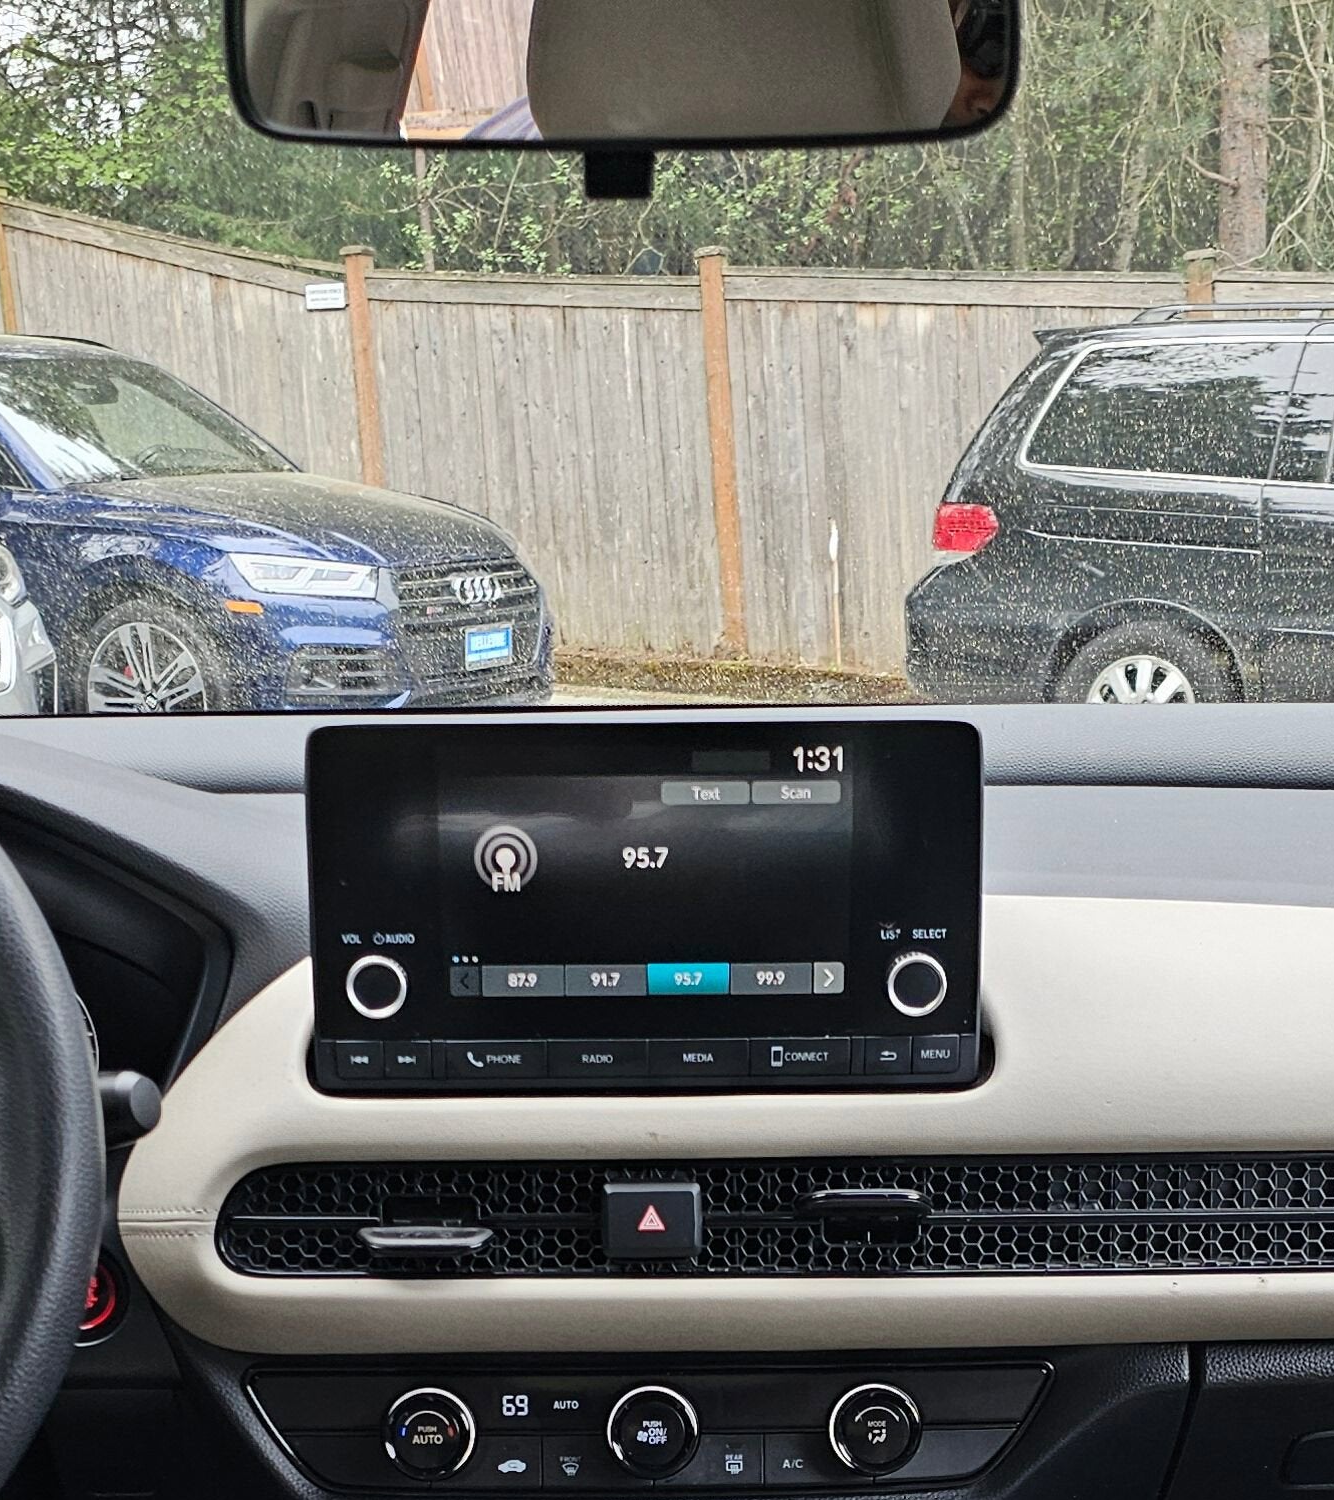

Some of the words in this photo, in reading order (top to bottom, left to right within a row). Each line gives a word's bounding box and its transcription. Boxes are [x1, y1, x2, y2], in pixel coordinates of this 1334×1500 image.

[792, 745, 844, 773] 1:31
[690, 785, 721, 801] Text
[780, 785, 811, 800] Scan
[622, 846, 668, 869] 95.7
[491, 871, 521, 893] FM
[341, 933, 362, 945] VOL
[385, 933, 415, 944] AUDIO
[912, 928, 947, 939] SELECT
[507, 973, 537, 988] 87.9
[590, 972, 621, 987] 91.7
[674, 971, 703, 987] 95.7
[756, 970, 785, 985] 99.9
[486, 1054, 522, 1065] PHONE
[581, 1054, 613, 1064] RADIO
[682, 1053, 714, 1063] MEDIA
[784, 1051, 829, 1062] CONNECT
[920, 1049, 950, 1060] MENU
[501, 1394, 529, 1416] 69
[553, 1400, 579, 1410] AUTO
[642, 1420, 663, 1428] PUSH
[412, 1434, 443, 1445] AUTO
[648, 1436, 667, 1445] OFF
[782, 1458, 804, 1469] A/C
